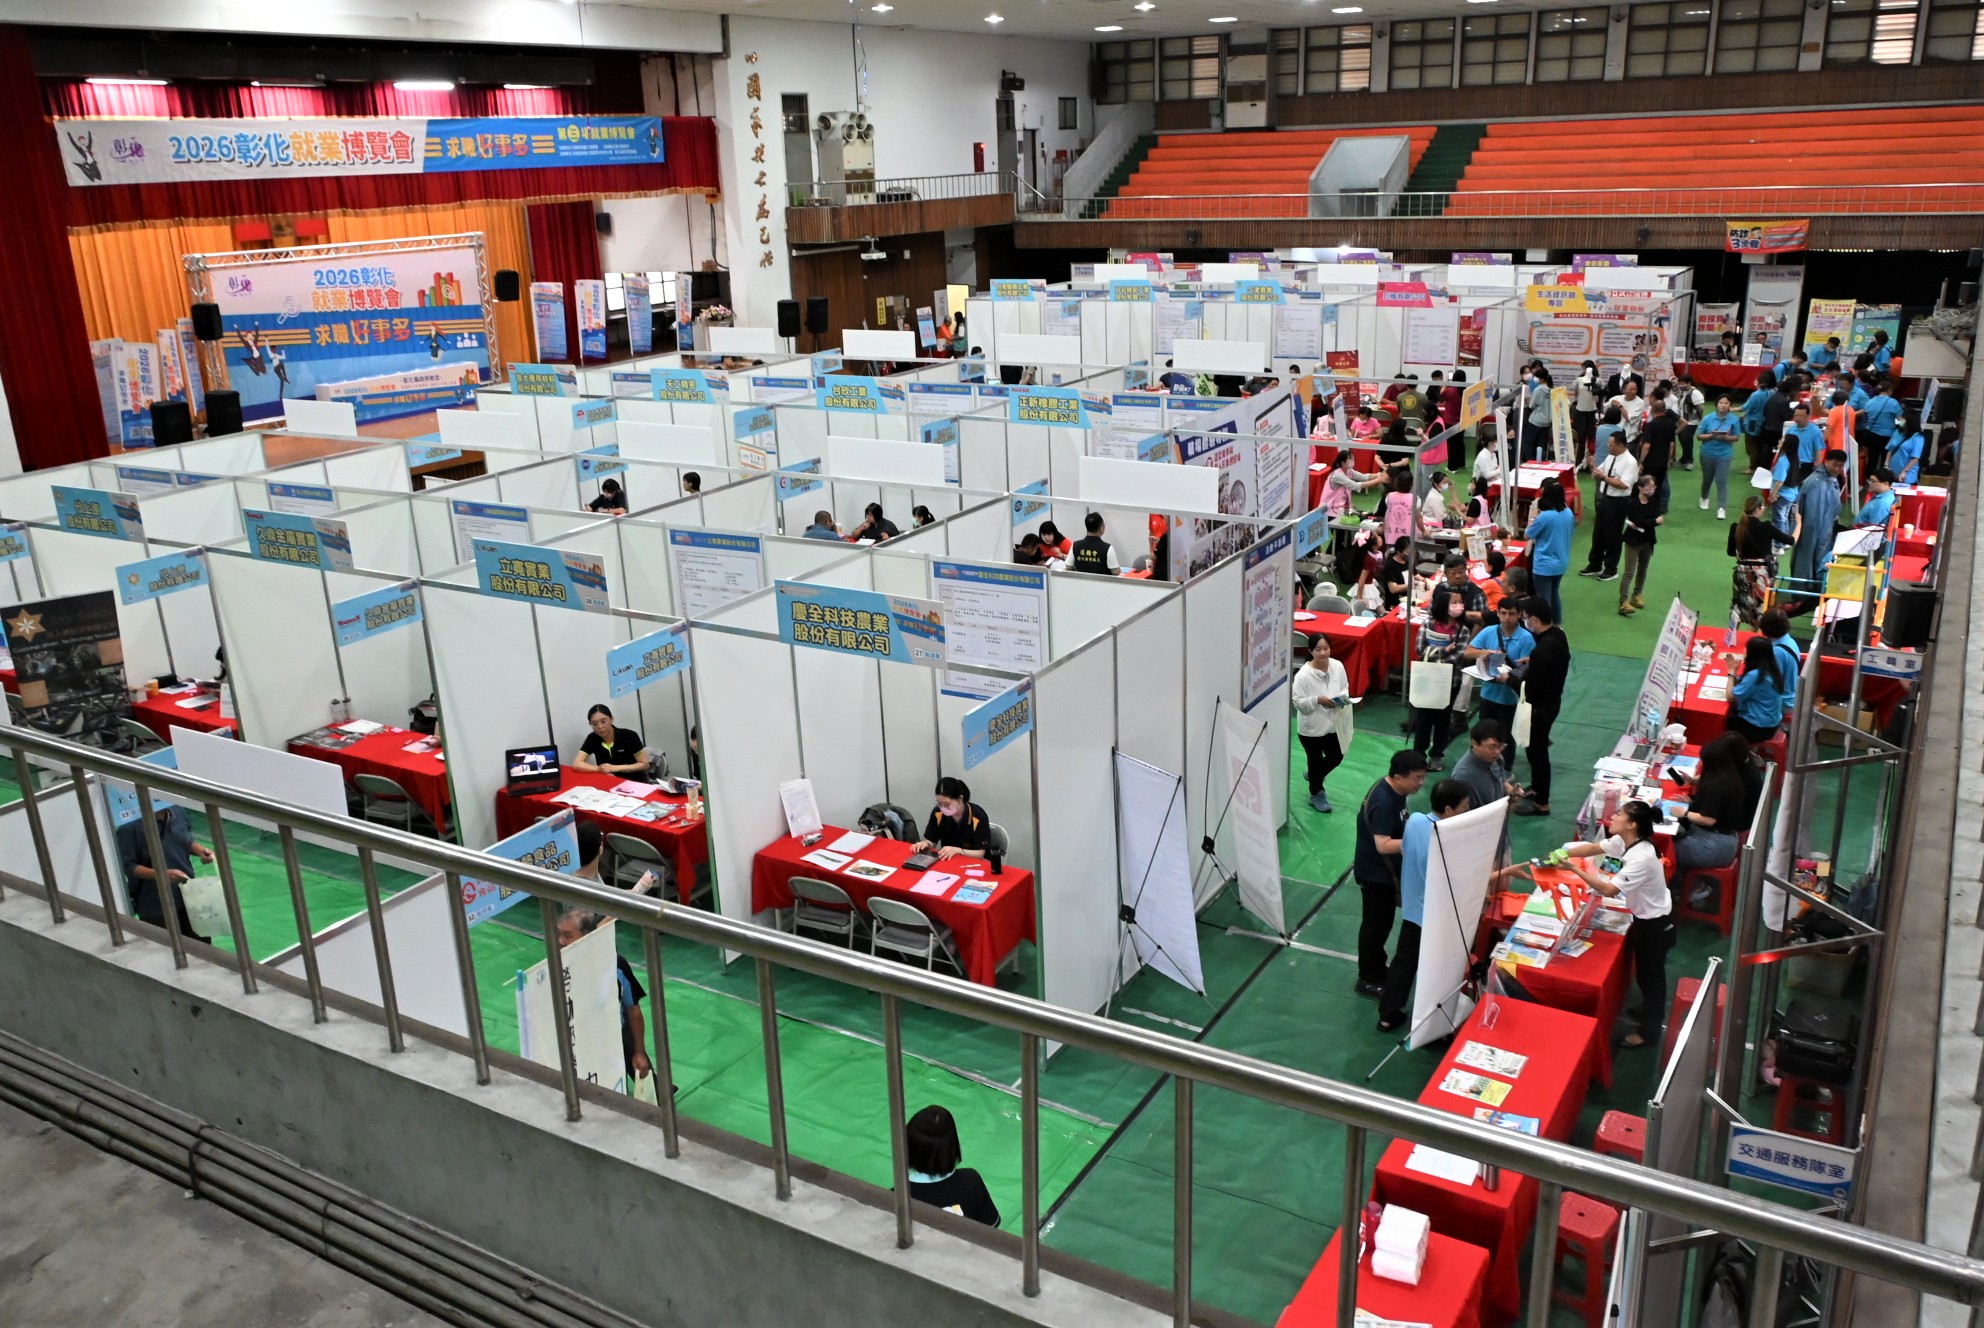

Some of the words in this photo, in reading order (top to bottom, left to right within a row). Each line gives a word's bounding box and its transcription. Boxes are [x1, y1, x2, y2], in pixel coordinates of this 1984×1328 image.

[168, 130, 413, 166] 2026彰化就業博覽會
[446, 134, 528, 158] 求職好事多
[314, 266, 395, 288] 2026彰化
[311, 288, 401, 313] 就業博覽會
[314, 318, 411, 346] 求職好事多
[825, 395, 877, 410] 股份有限公司
[1018, 396, 1078, 411] 正新橡膠工業
[1018, 408, 1079, 424] 股份有限公司
[498, 556, 552, 582] 立寬實業
[489, 574, 567, 603] 股份有限公司
[791, 599, 890, 635] 慶全科技農業
[793, 622, 891, 656] 股份有限公司
[915, 649, 923, 658] 27
[514, 840, 558, 866] 食品
[1738, 1142, 1847, 1180] 交通服務隊室
